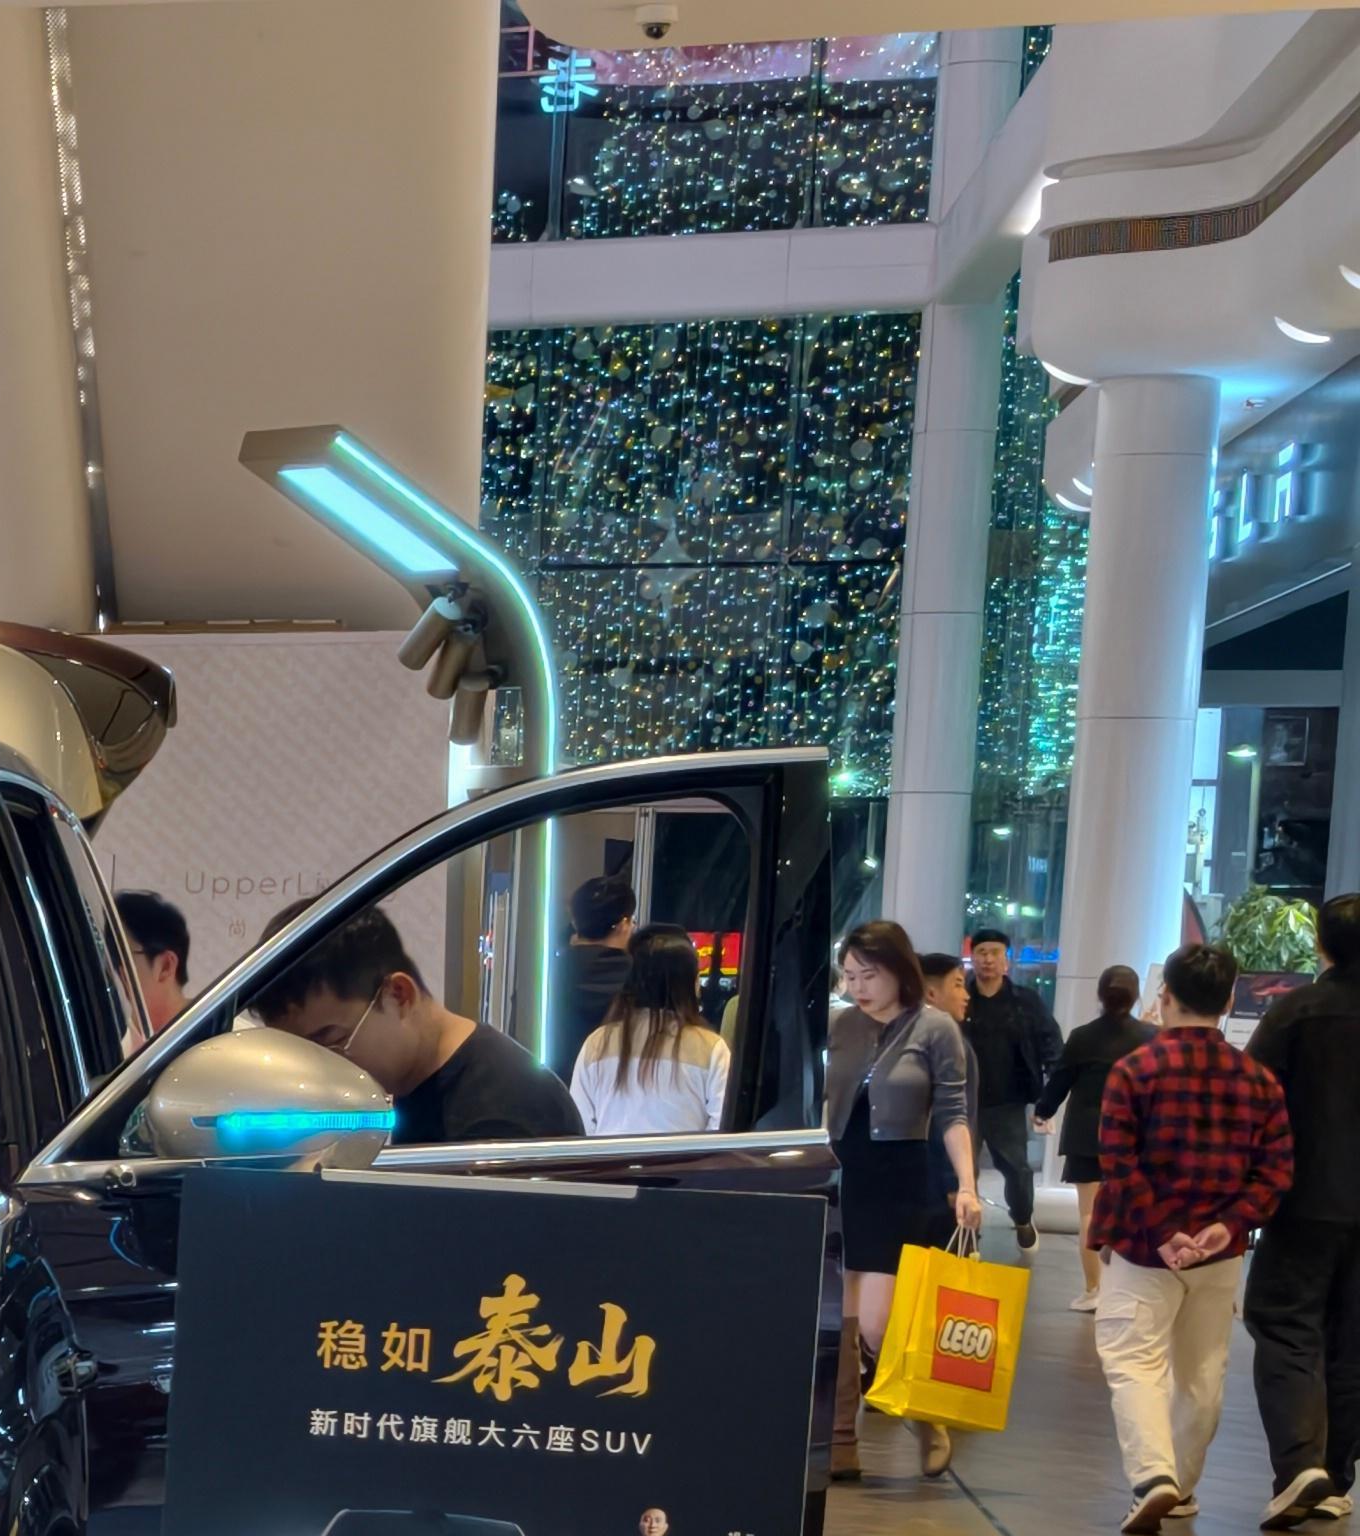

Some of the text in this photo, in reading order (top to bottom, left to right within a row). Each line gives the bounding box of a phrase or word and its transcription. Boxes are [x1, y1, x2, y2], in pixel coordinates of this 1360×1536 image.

[315, 1274, 656, 1402] 稳如泰山
[939, 1318, 993, 1359] LEGO
[309, 1408, 653, 1455] 新时代旗舰大六座SUV
